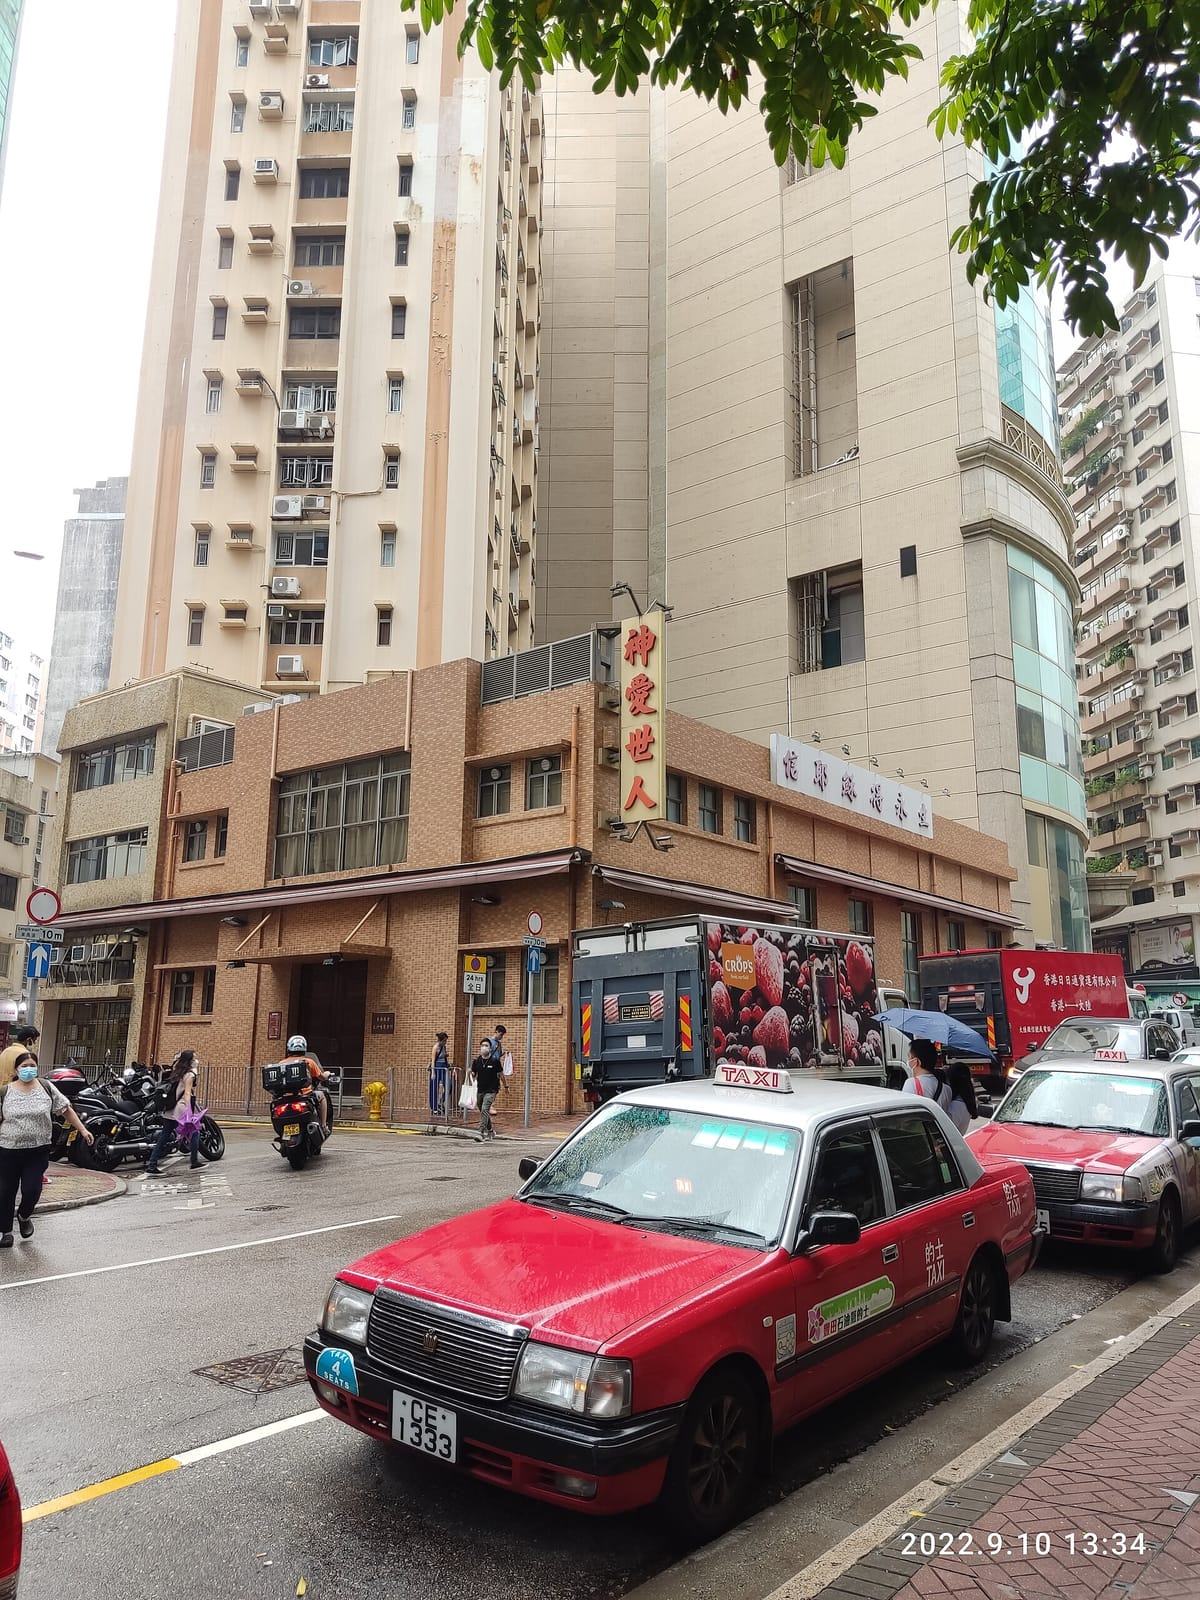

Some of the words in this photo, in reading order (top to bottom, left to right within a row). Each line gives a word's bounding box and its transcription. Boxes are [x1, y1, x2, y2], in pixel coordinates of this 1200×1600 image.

[623, 624, 657, 811] 神愛世人
[725, 959, 754, 974] CROP'S
[467, 983, 481, 992] 全日
[475, 974, 484, 982] hrs
[1097, 1050, 1122, 1060] TAXI
[721, 1067, 779, 1088] TAXI
[675, 1178, 692, 1193] TAXI
[1002, 1180, 1019, 1201] 的士
[1007, 1198, 1021, 1219] TAXI
[924, 1238, 944, 1265] 的士
[926, 1259, 945, 1288] TAXI
[330, 1350, 349, 1364] TAXI
[331, 1361, 341, 1376] 4
[323, 1371, 350, 1390] SEATS
[410, 1399, 438, 1431] CE
[399, 1417, 452, 1459] 1333
